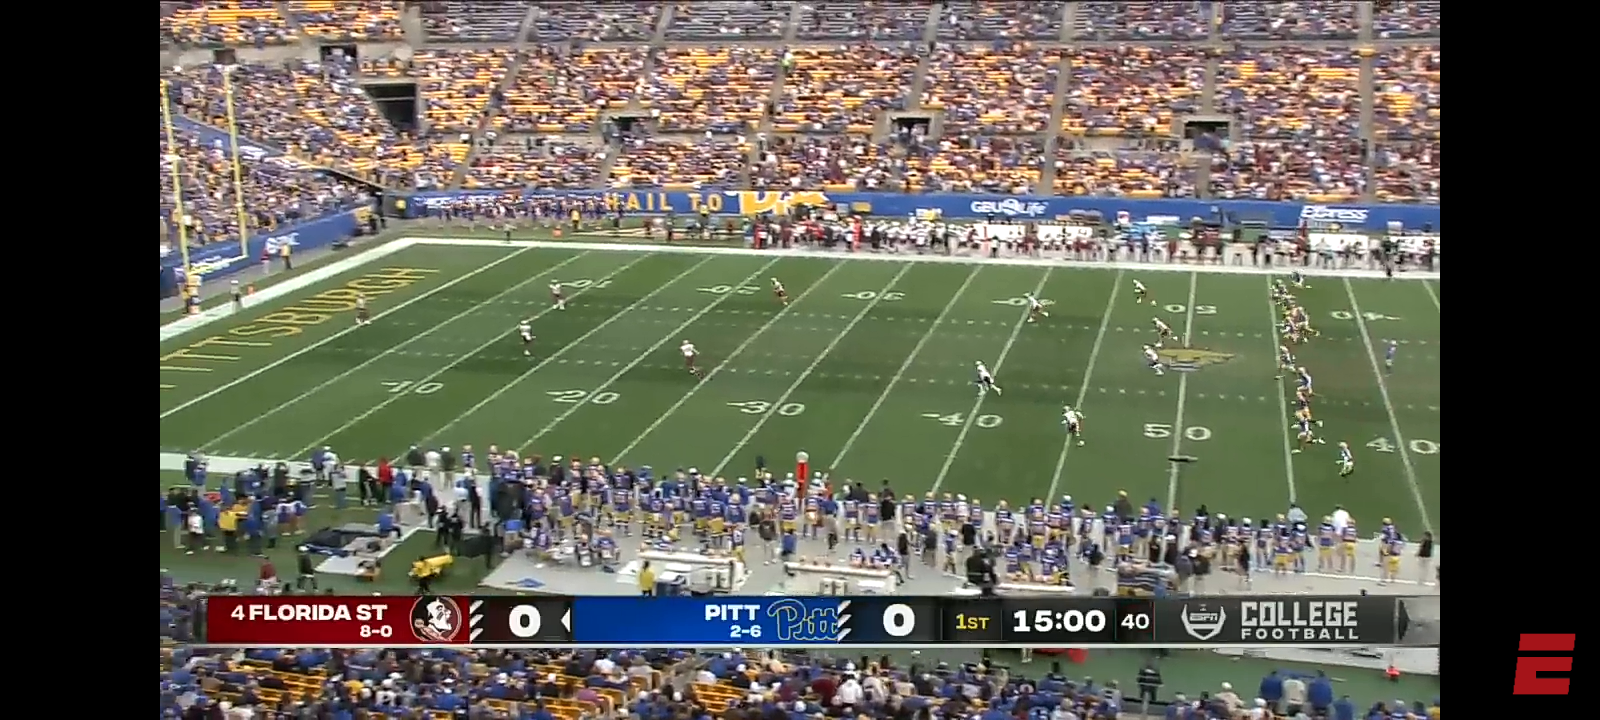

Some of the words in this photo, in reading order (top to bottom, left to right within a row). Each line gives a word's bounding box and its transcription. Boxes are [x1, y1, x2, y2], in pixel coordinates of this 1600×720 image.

[687, 192, 722, 211] TO
[1144, 423, 1211, 440] 50
[1366, 438, 1439, 454] 40
